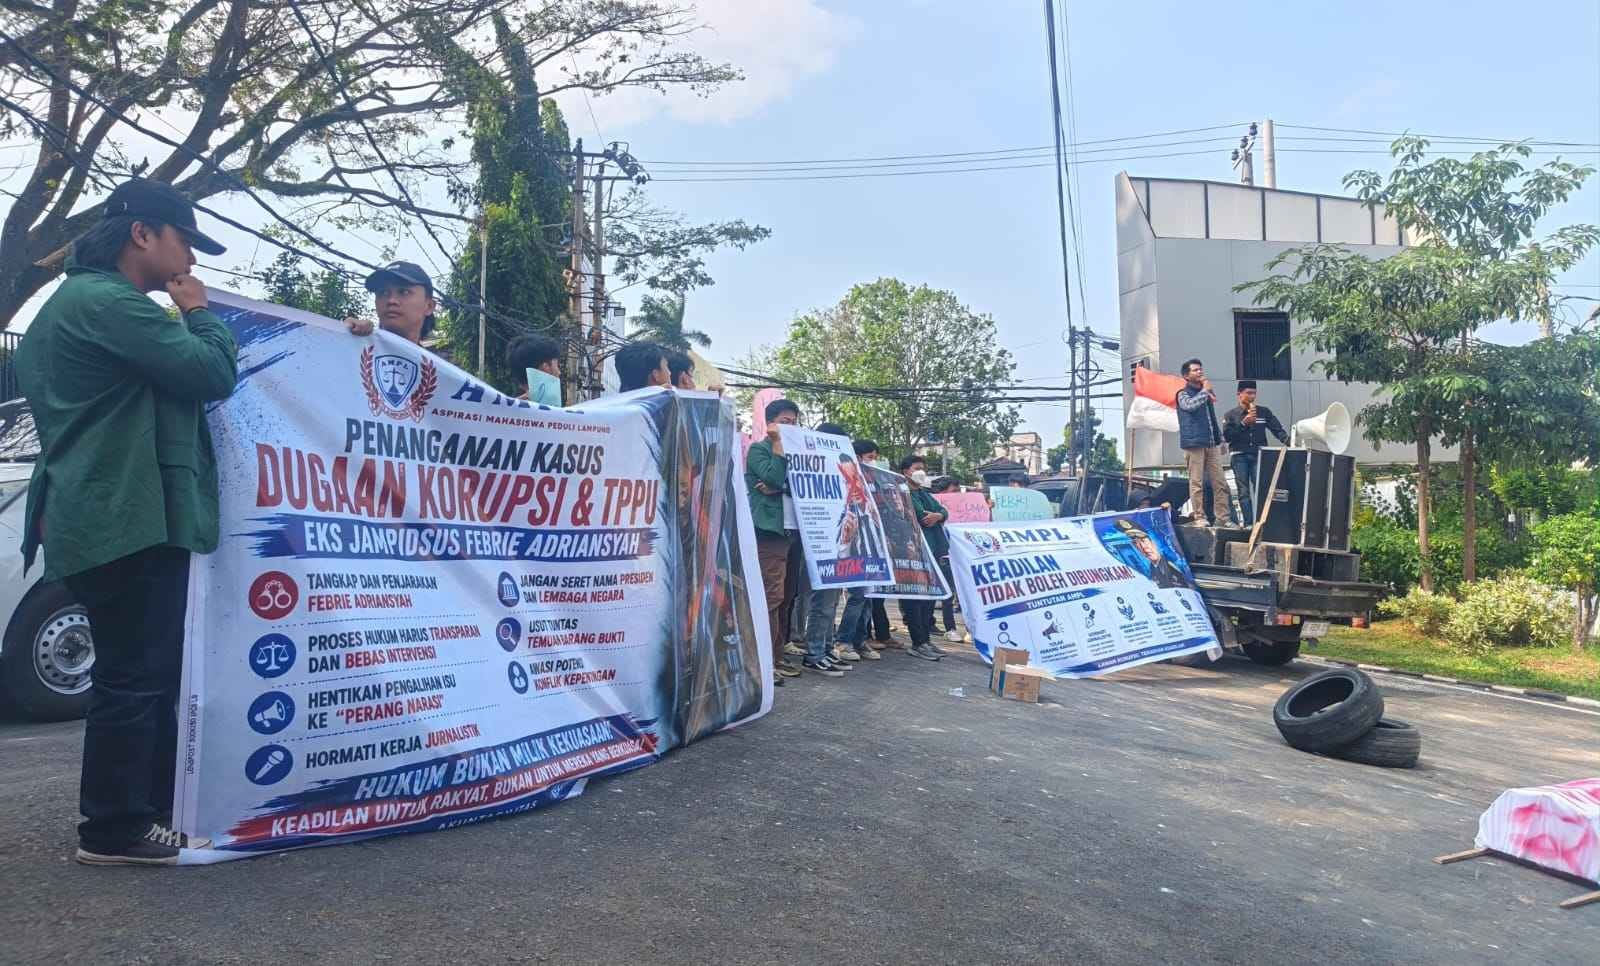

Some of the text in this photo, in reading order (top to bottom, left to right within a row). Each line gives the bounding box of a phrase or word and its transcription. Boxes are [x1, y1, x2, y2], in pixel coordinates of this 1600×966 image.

[381, 360, 409, 370] AMPL
[431, 408, 483, 423] ASPIRASI
[485, 415, 546, 429] MAHASISWA
[547, 422, 576, 432] PEDULI
[344, 418, 604, 475] PENANGANAN KASUS
[816, 437, 841, 449] AMPL
[785, 453, 826, 473] BOIKOT
[256, 443, 658, 527] DUGAAN KORUPSI & TPPU
[304, 521, 640, 558] EKS JAMPIDSUS FEBRIE ADRIANSYAH
[999, 528, 1070, 542] AMPL
[307, 573, 438, 590] TANGKAP DAN PENJARAKAN
[520, 574, 559, 588] JANGAN
[561, 575, 591, 588] SERET
[593, 574, 618, 587] NAMA
[970, 554, 1061, 586] KEADILAN
[539, 591, 588, 604] LEMBAGA
[590, 589, 624, 603] NEGARA
[977, 565, 1136, 605] TIDAK BOLEH DIBUNGKAM!
[308, 593, 413, 612] FEBRIE ADRIANSYAH
[308, 624, 481, 653] PROSES HUKUM HARUS TRANSPARAN
[598, 631, 625, 643] BUKTI
[308, 645, 437, 674] DAN BEBAS INTERVENSI
[308, 674, 456, 709] HENTIKAN PENGALIHAN ISU
[307, 712, 328, 730] KE
[306, 724, 481, 769] HORMATI KERJA JURNALISTIK
[354, 762, 449, 800] HUKUM
[452, 744, 512, 784] BUKAN
[510, 738, 549, 768] MILIK
[271, 806, 369, 838] KEADILAN
[375, 798, 427, 823] UNTUK
[493, 772, 534, 798] BUKAN
[533, 763, 565, 785] UNTUK
[561, 755, 594, 773] MEREKA
